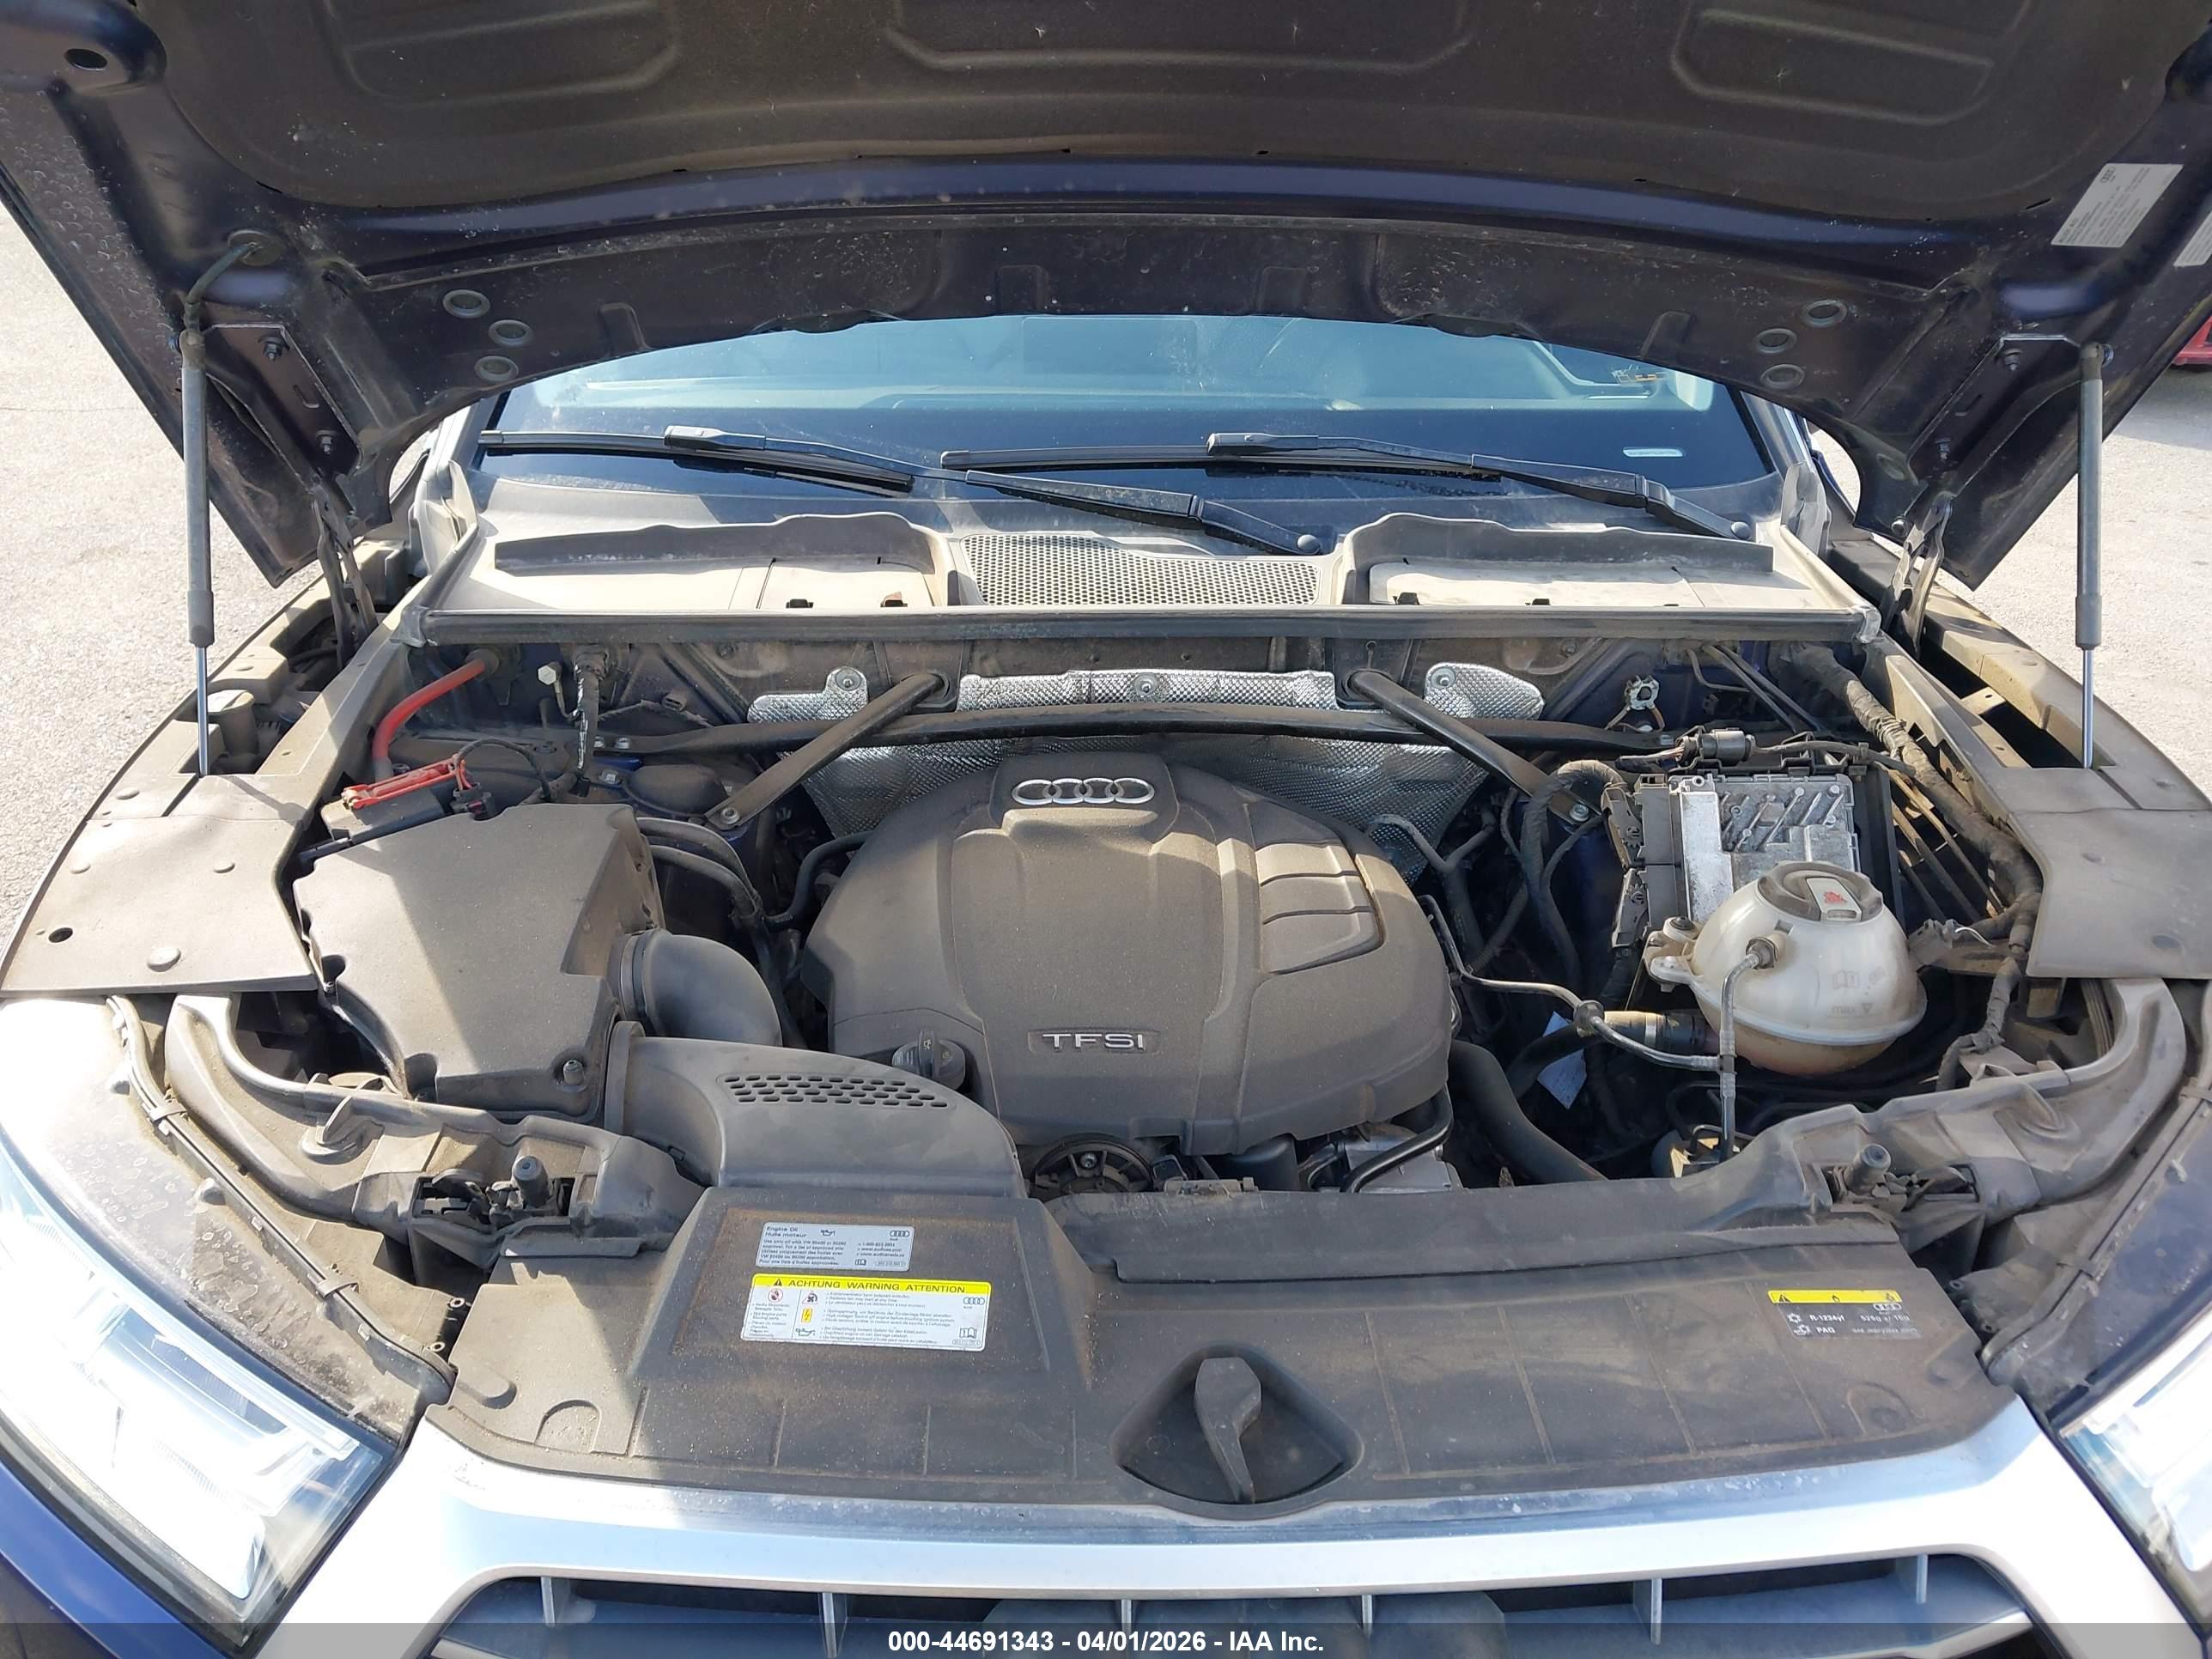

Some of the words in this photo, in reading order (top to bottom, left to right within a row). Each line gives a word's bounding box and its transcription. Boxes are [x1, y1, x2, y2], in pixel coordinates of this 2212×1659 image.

[1042, 1033, 1144, 1049] TFSI
[788, 1279, 841, 1289] ACHTUNG
[847, 1282, 900, 1291] WARNING
[905, 1284, 965, 1293] ATTENTION
